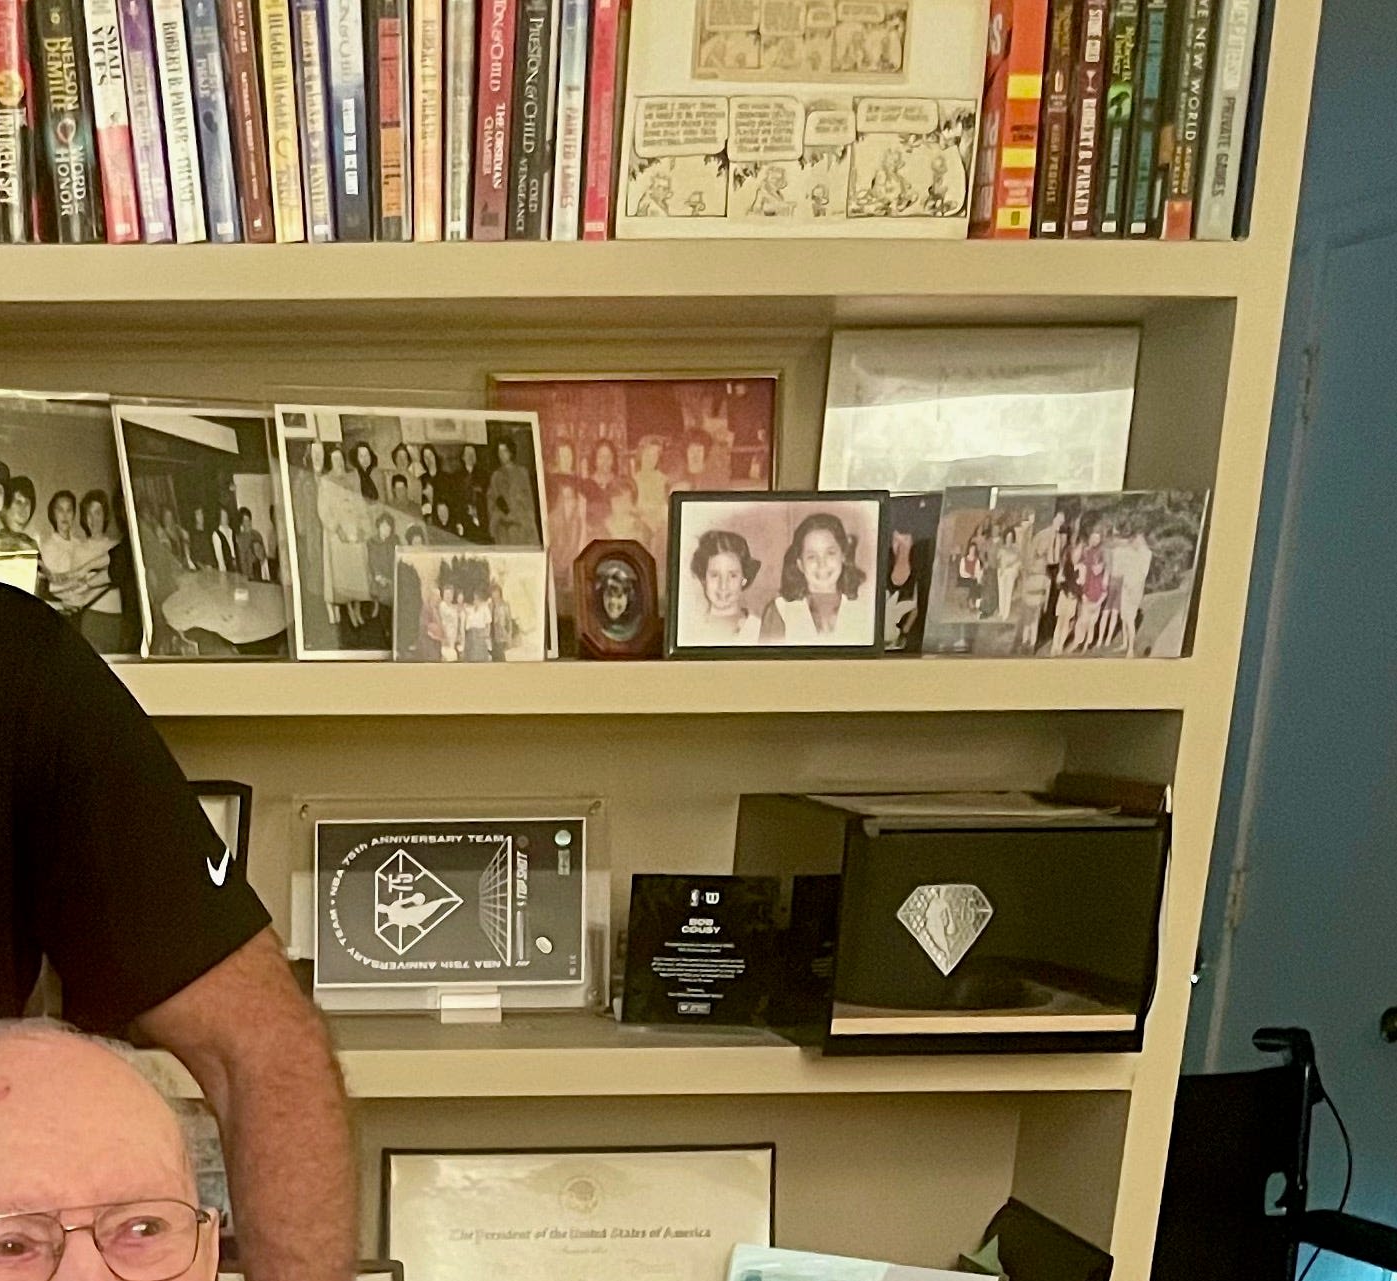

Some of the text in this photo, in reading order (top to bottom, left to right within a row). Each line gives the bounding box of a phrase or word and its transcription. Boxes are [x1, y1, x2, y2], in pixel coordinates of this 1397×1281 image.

[91, 26, 108, 87] VICES
[162, 21, 183, 73] ROBERT
[524, 17, 544, 84] PRESTON
[1192, 27, 1206, 71] NEW
[60, 37, 79, 112] NELSON
[169, 91, 190, 143] PARKER
[522, 102, 539, 154] CHILD
[1185, 79, 1202, 142] WORLD
[69, 146, 87, 200] WORD
[1211, 96, 1237, 197] PRIVATE GAMES
[0, 177, 19, 205] SPY
[55, 149, 74, 217] HONOR
[370, 833, 463, 847] ANNIVERSARY
[467, 833, 505, 844] TEAM
[663, 1226, 712, 1239] America
